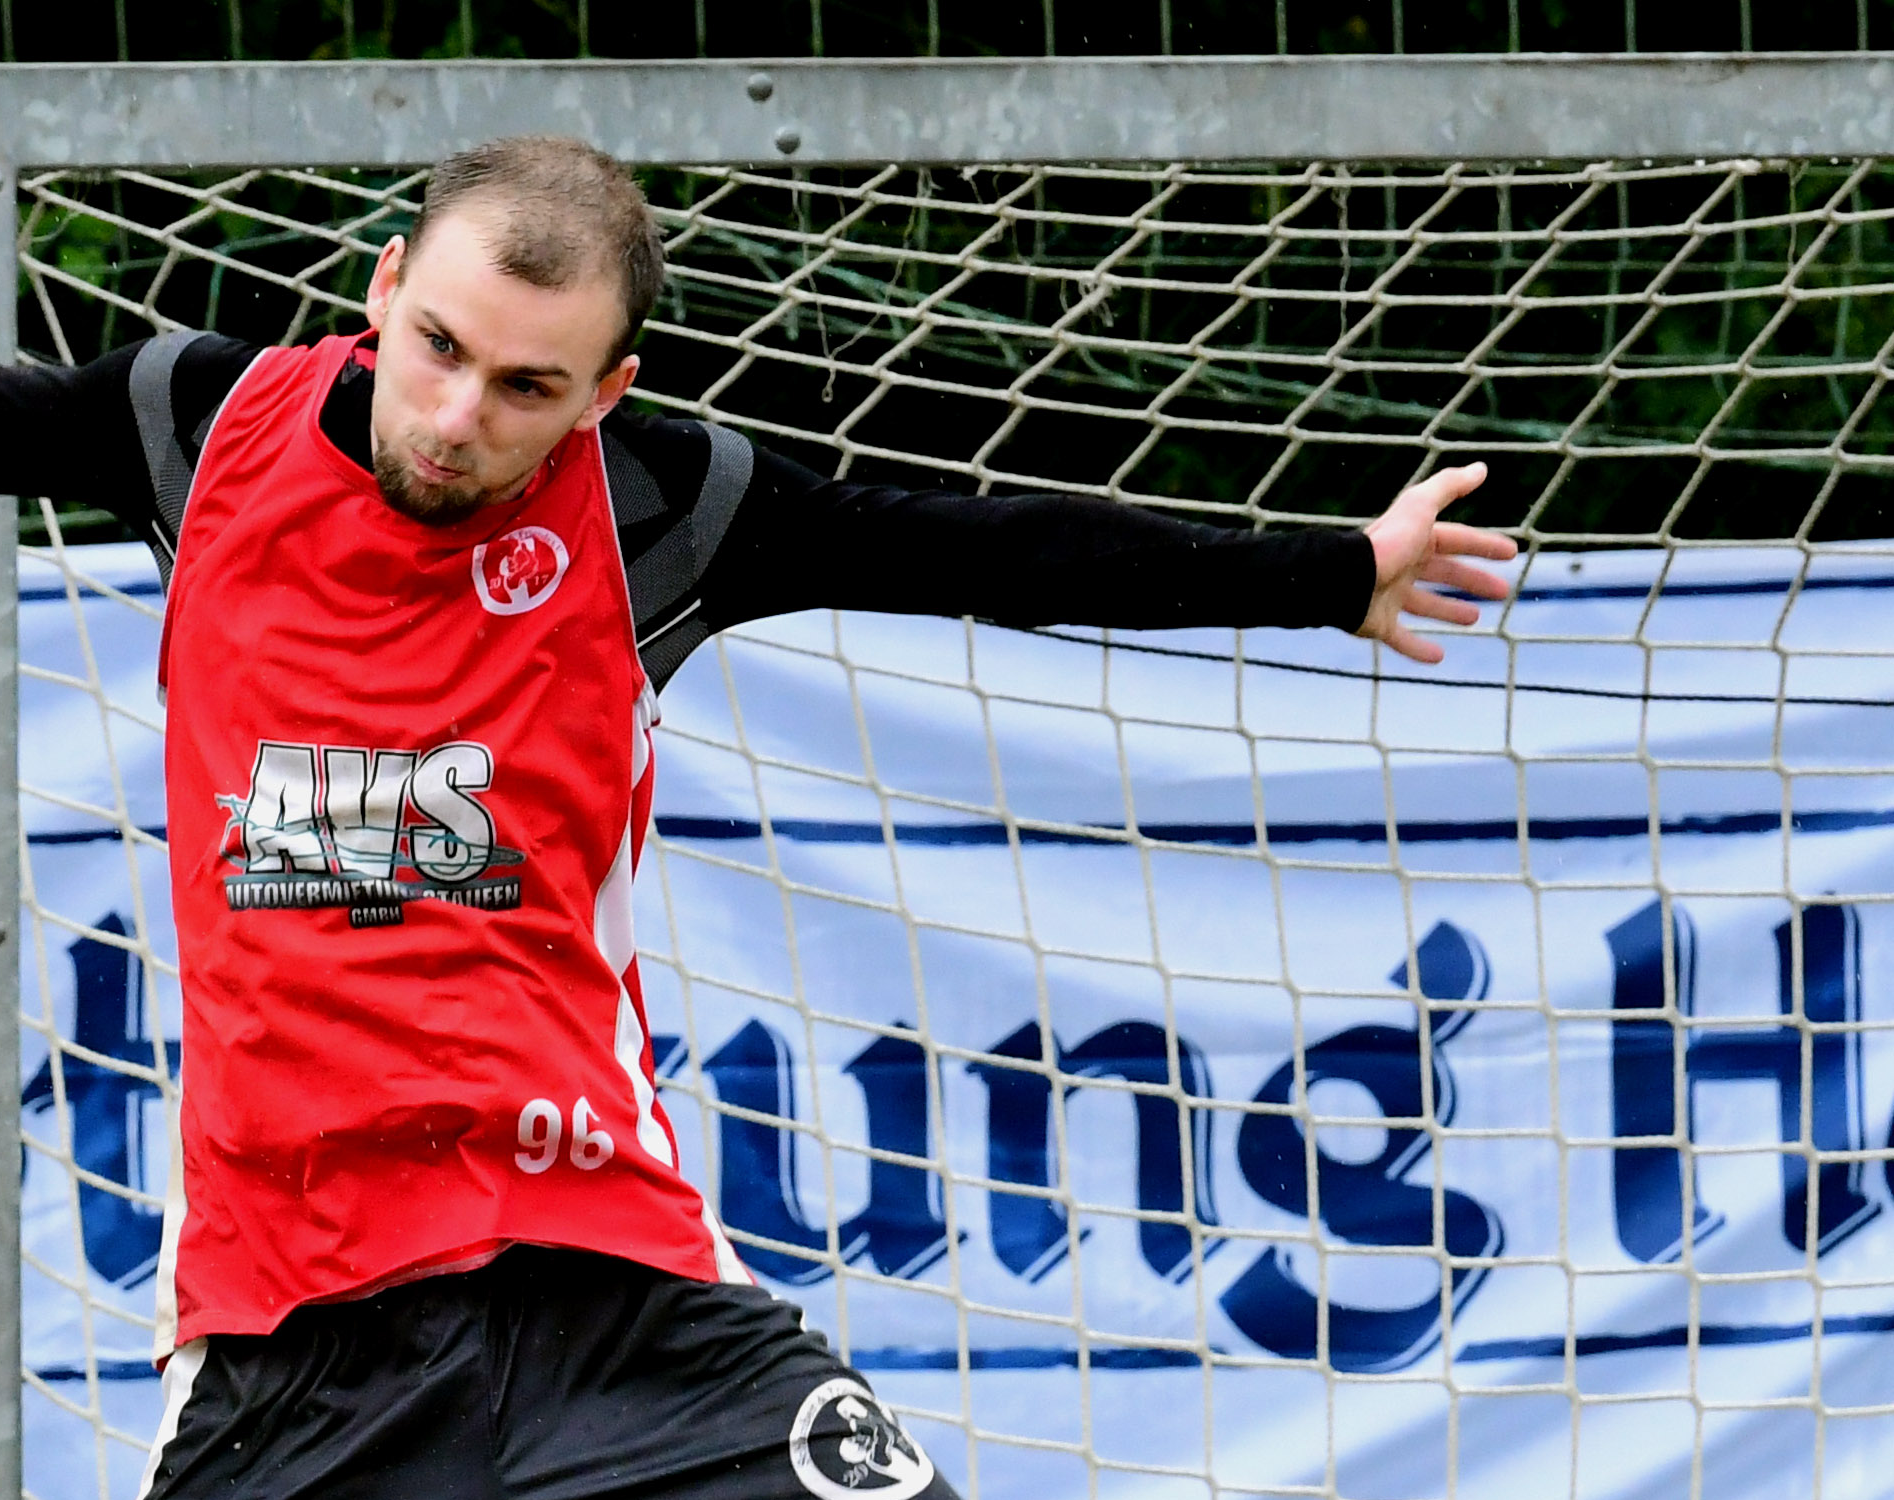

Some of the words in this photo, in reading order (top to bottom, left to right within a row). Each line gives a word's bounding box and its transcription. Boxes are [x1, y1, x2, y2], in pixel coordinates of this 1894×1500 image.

[241, 739, 495, 886] AVS
[514, 1096, 615, 1175] 96
[1602, 892, 1894, 1267] H
